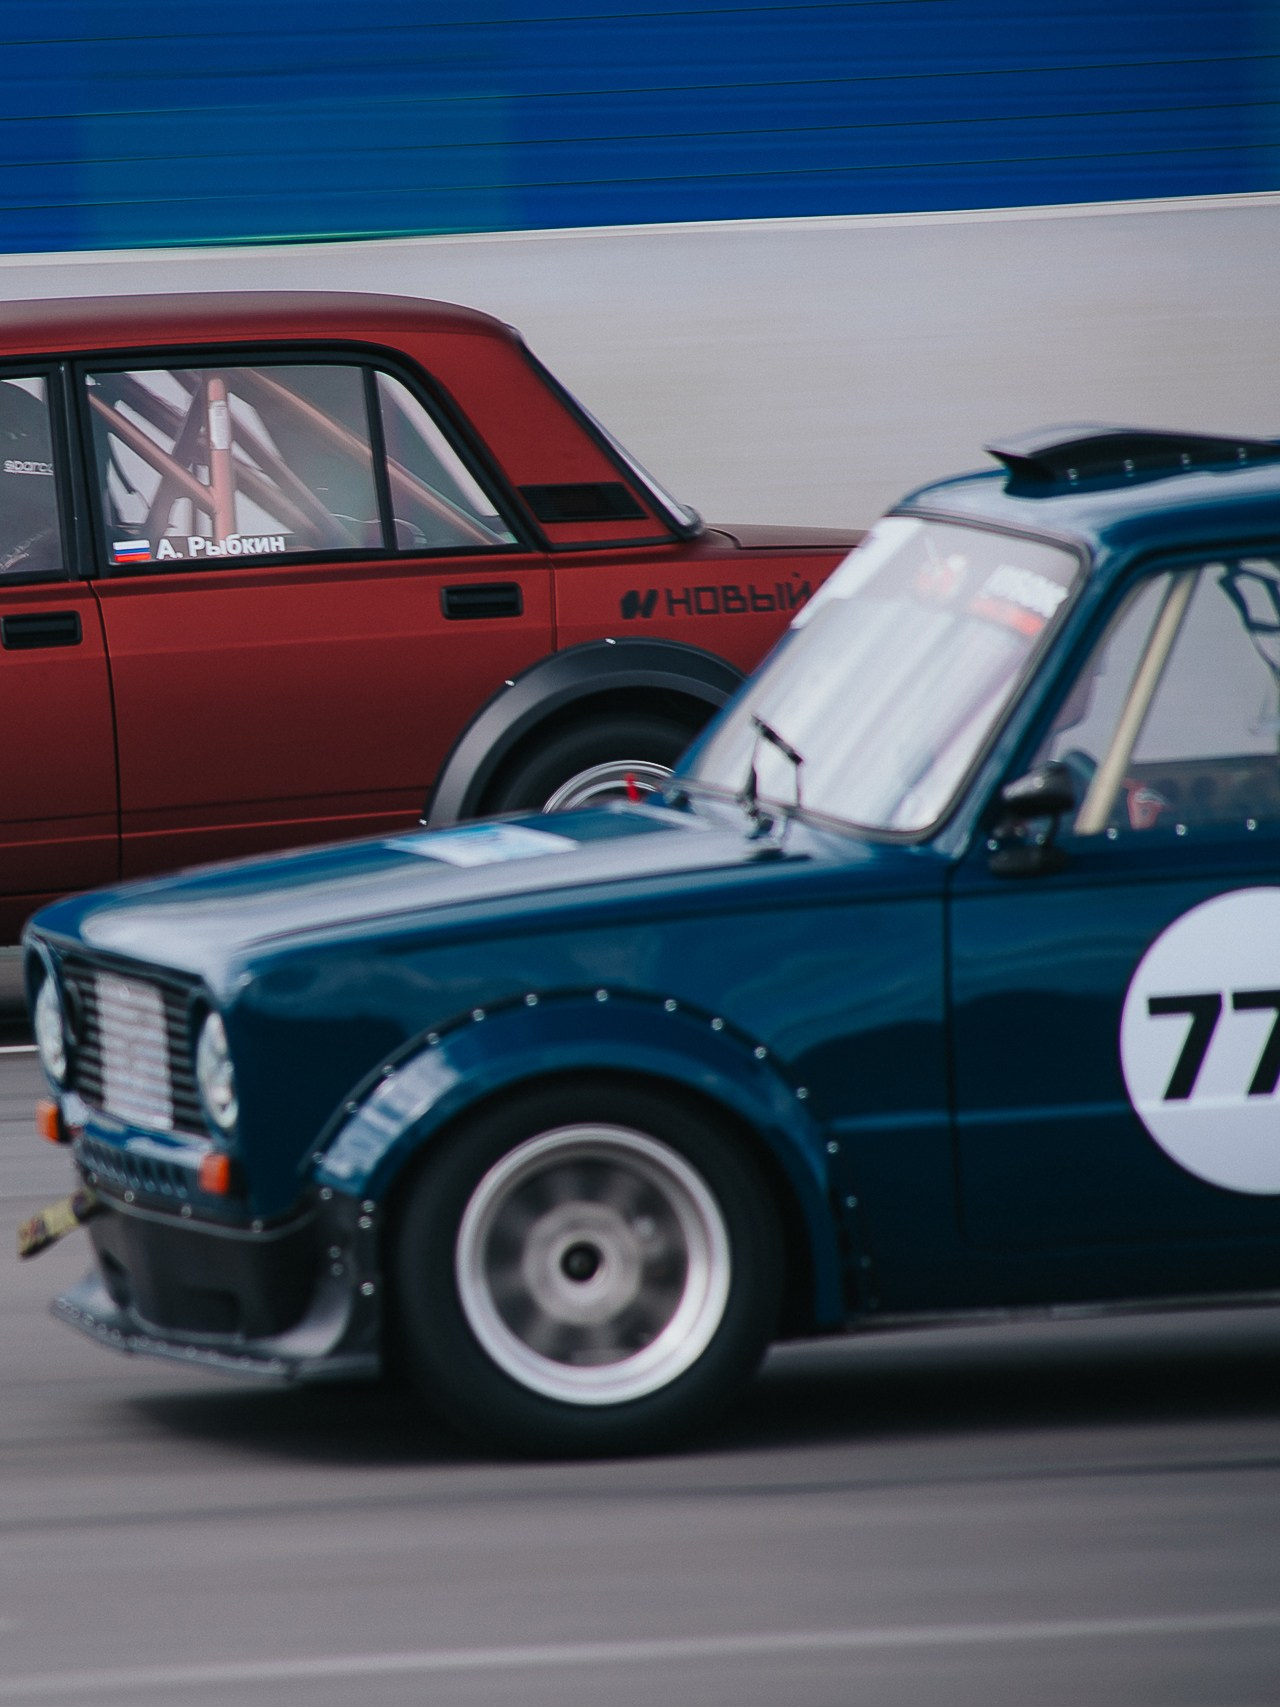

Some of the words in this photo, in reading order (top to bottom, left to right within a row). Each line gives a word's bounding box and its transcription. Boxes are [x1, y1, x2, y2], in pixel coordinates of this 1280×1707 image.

[155, 538, 184, 560] А.
[187, 533, 286, 558] Рыбкин
[1147, 989, 1280, 1101] 77
